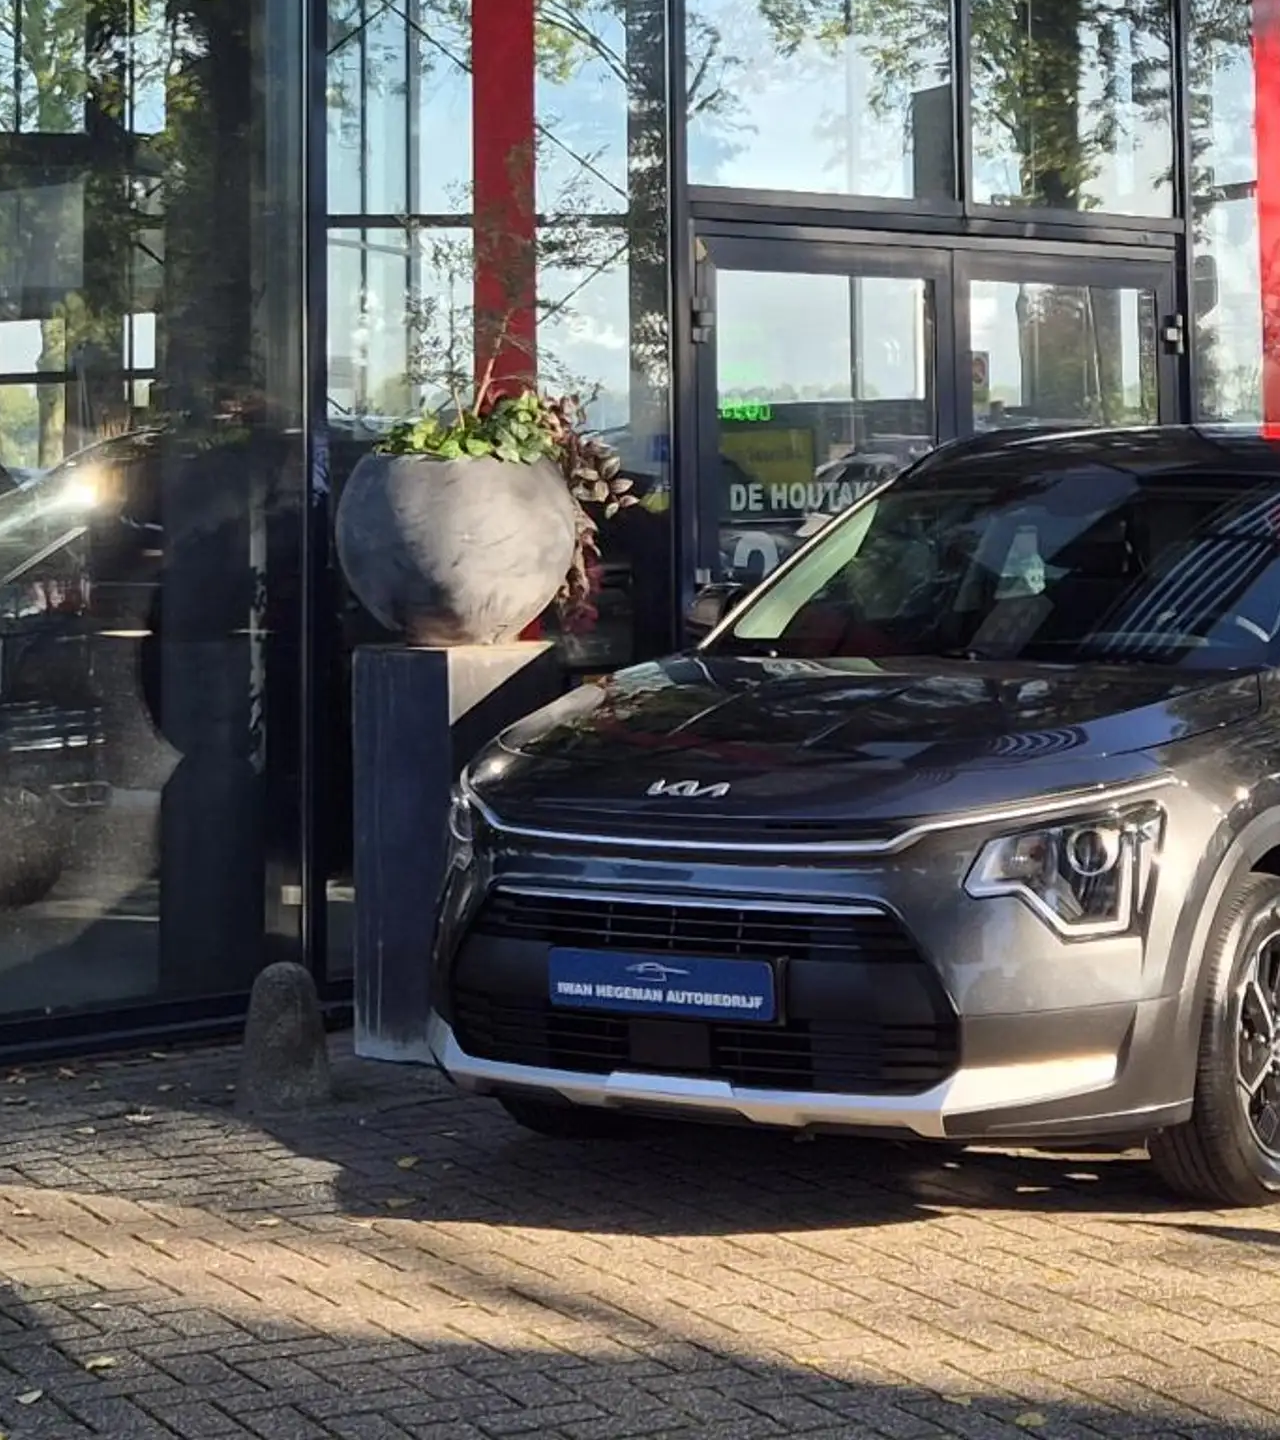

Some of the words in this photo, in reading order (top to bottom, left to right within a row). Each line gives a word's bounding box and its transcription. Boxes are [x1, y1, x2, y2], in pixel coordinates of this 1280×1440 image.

[730, 482, 764, 511] DE
[770, 480, 877, 512] HOUTAK
[646, 778, 731, 798] KIA
[557, 981, 593, 997] IWAN
[595, 984, 663, 1002] HEGEMAN
[665, 990, 764, 1010] AUTOBEDRIJF
